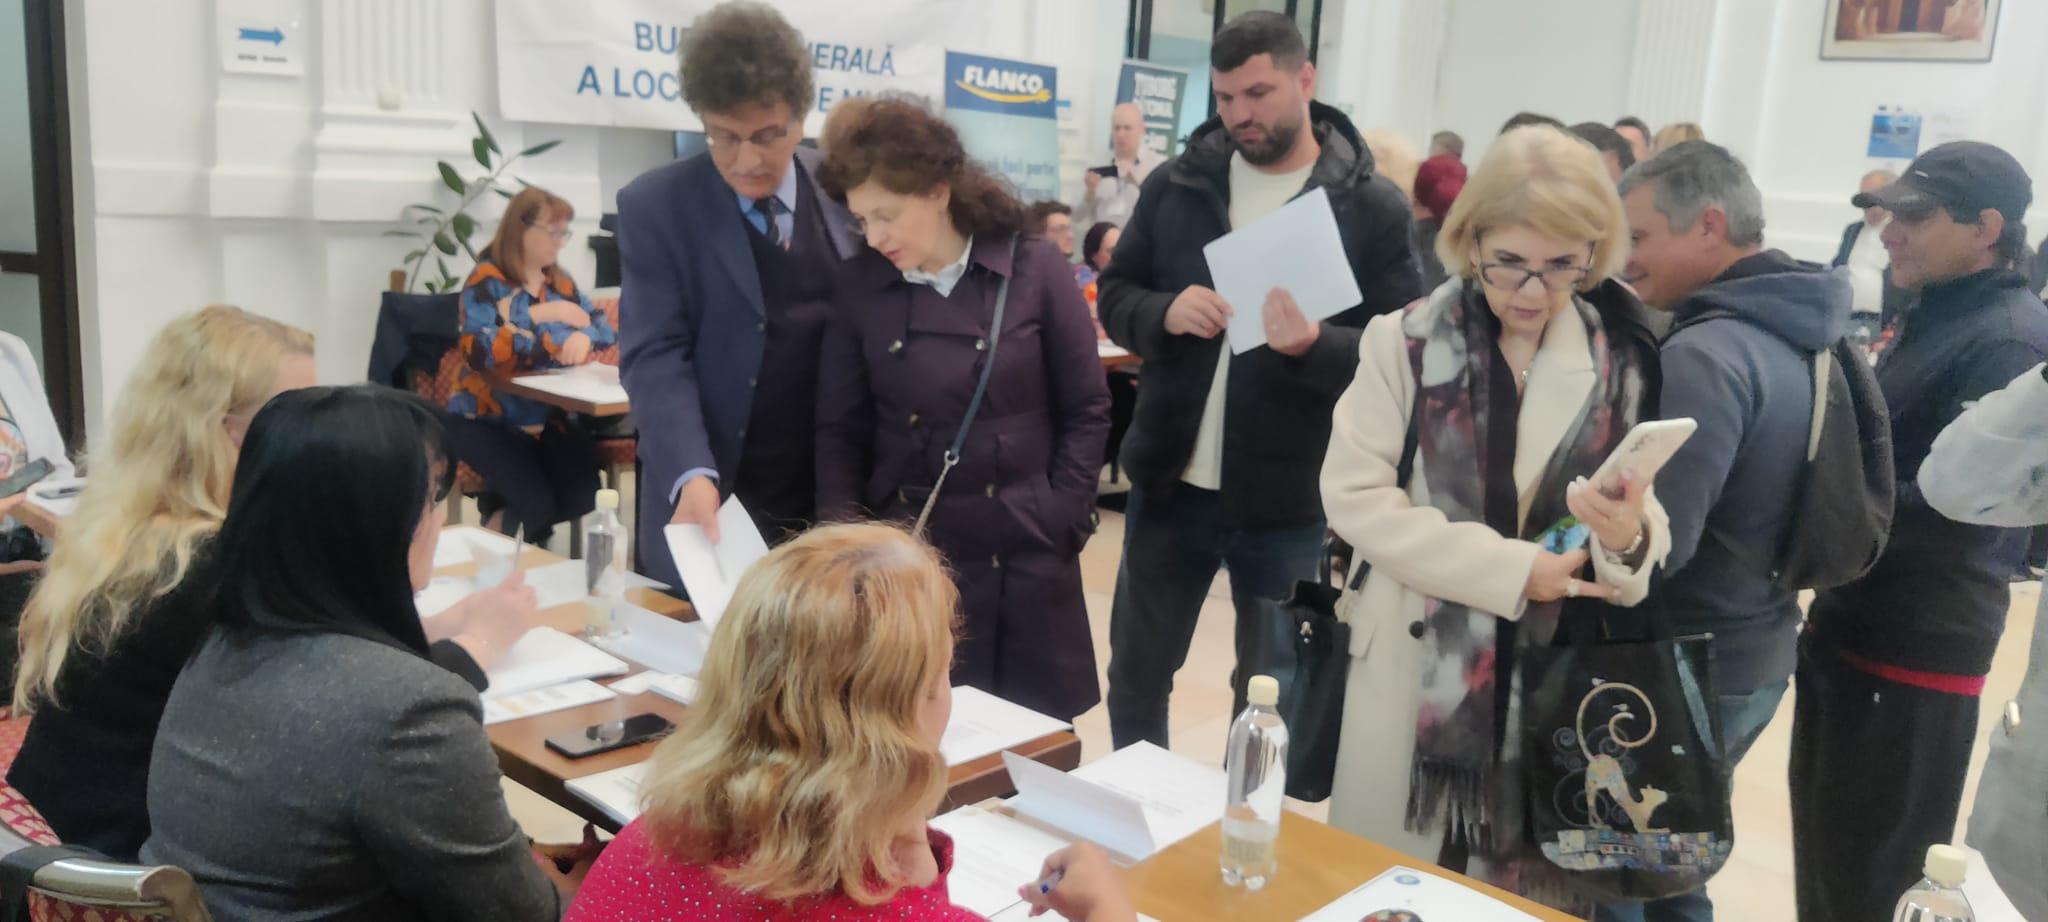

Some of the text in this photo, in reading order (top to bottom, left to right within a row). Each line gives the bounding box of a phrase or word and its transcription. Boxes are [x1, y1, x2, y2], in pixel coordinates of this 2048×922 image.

[634, 21, 678, 55] BU
[576, 64, 834, 113] A LOC E
[963, 64, 1044, 94] FLANCO
